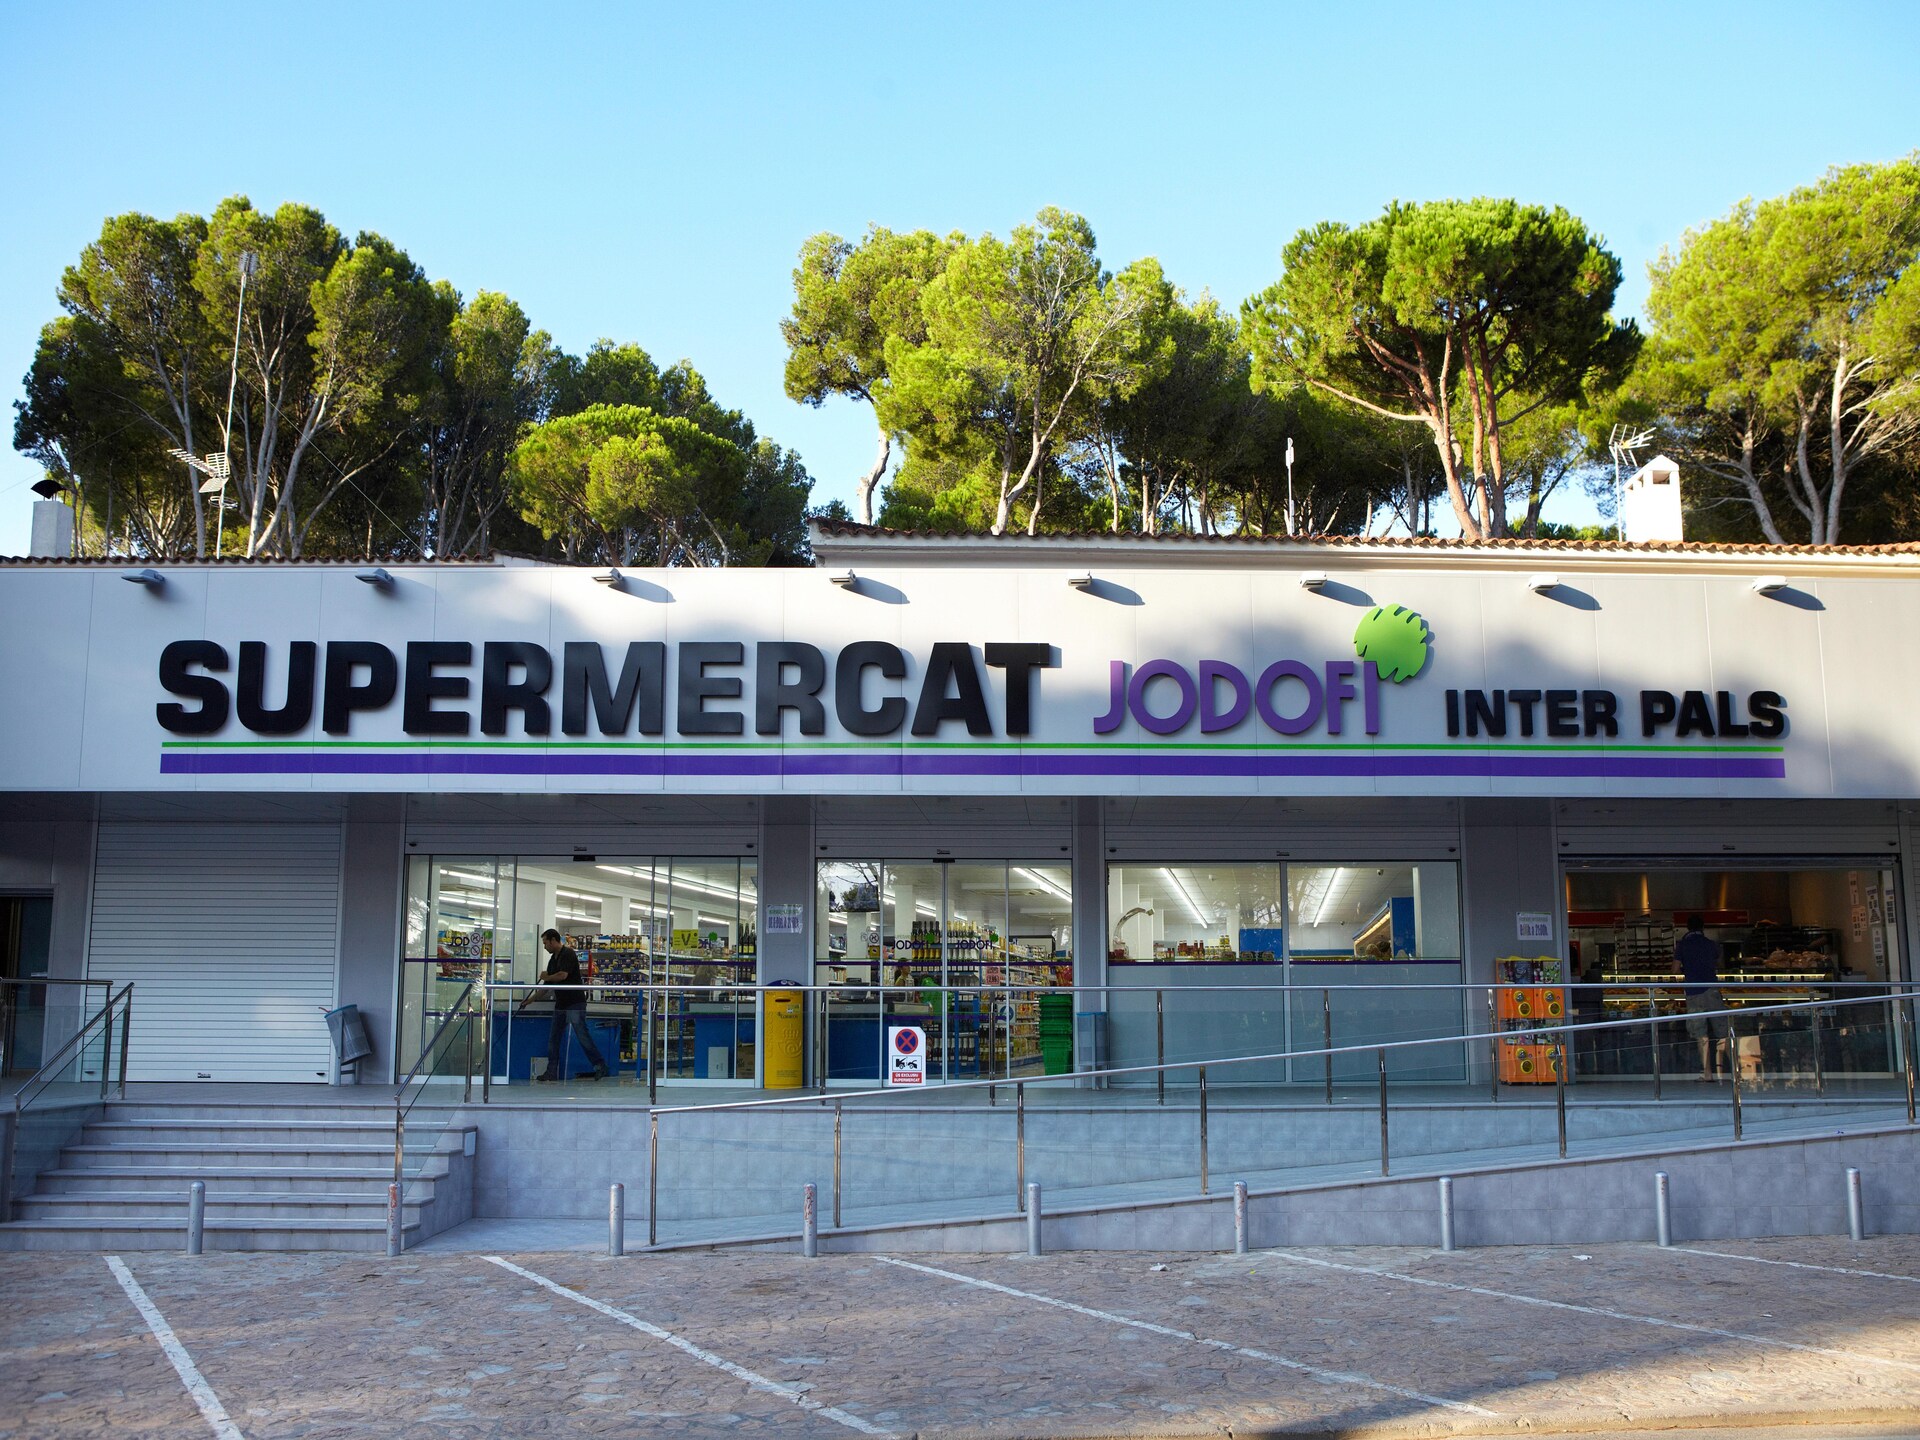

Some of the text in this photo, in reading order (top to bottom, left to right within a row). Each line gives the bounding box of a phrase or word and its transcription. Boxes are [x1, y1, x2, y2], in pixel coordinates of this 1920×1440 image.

[156, 639, 1786, 738] SUPERMERCAT JODOFI INTER PALS
[891, 939, 929, 950] JODOFI
[956, 939, 993, 950] JODOFI
